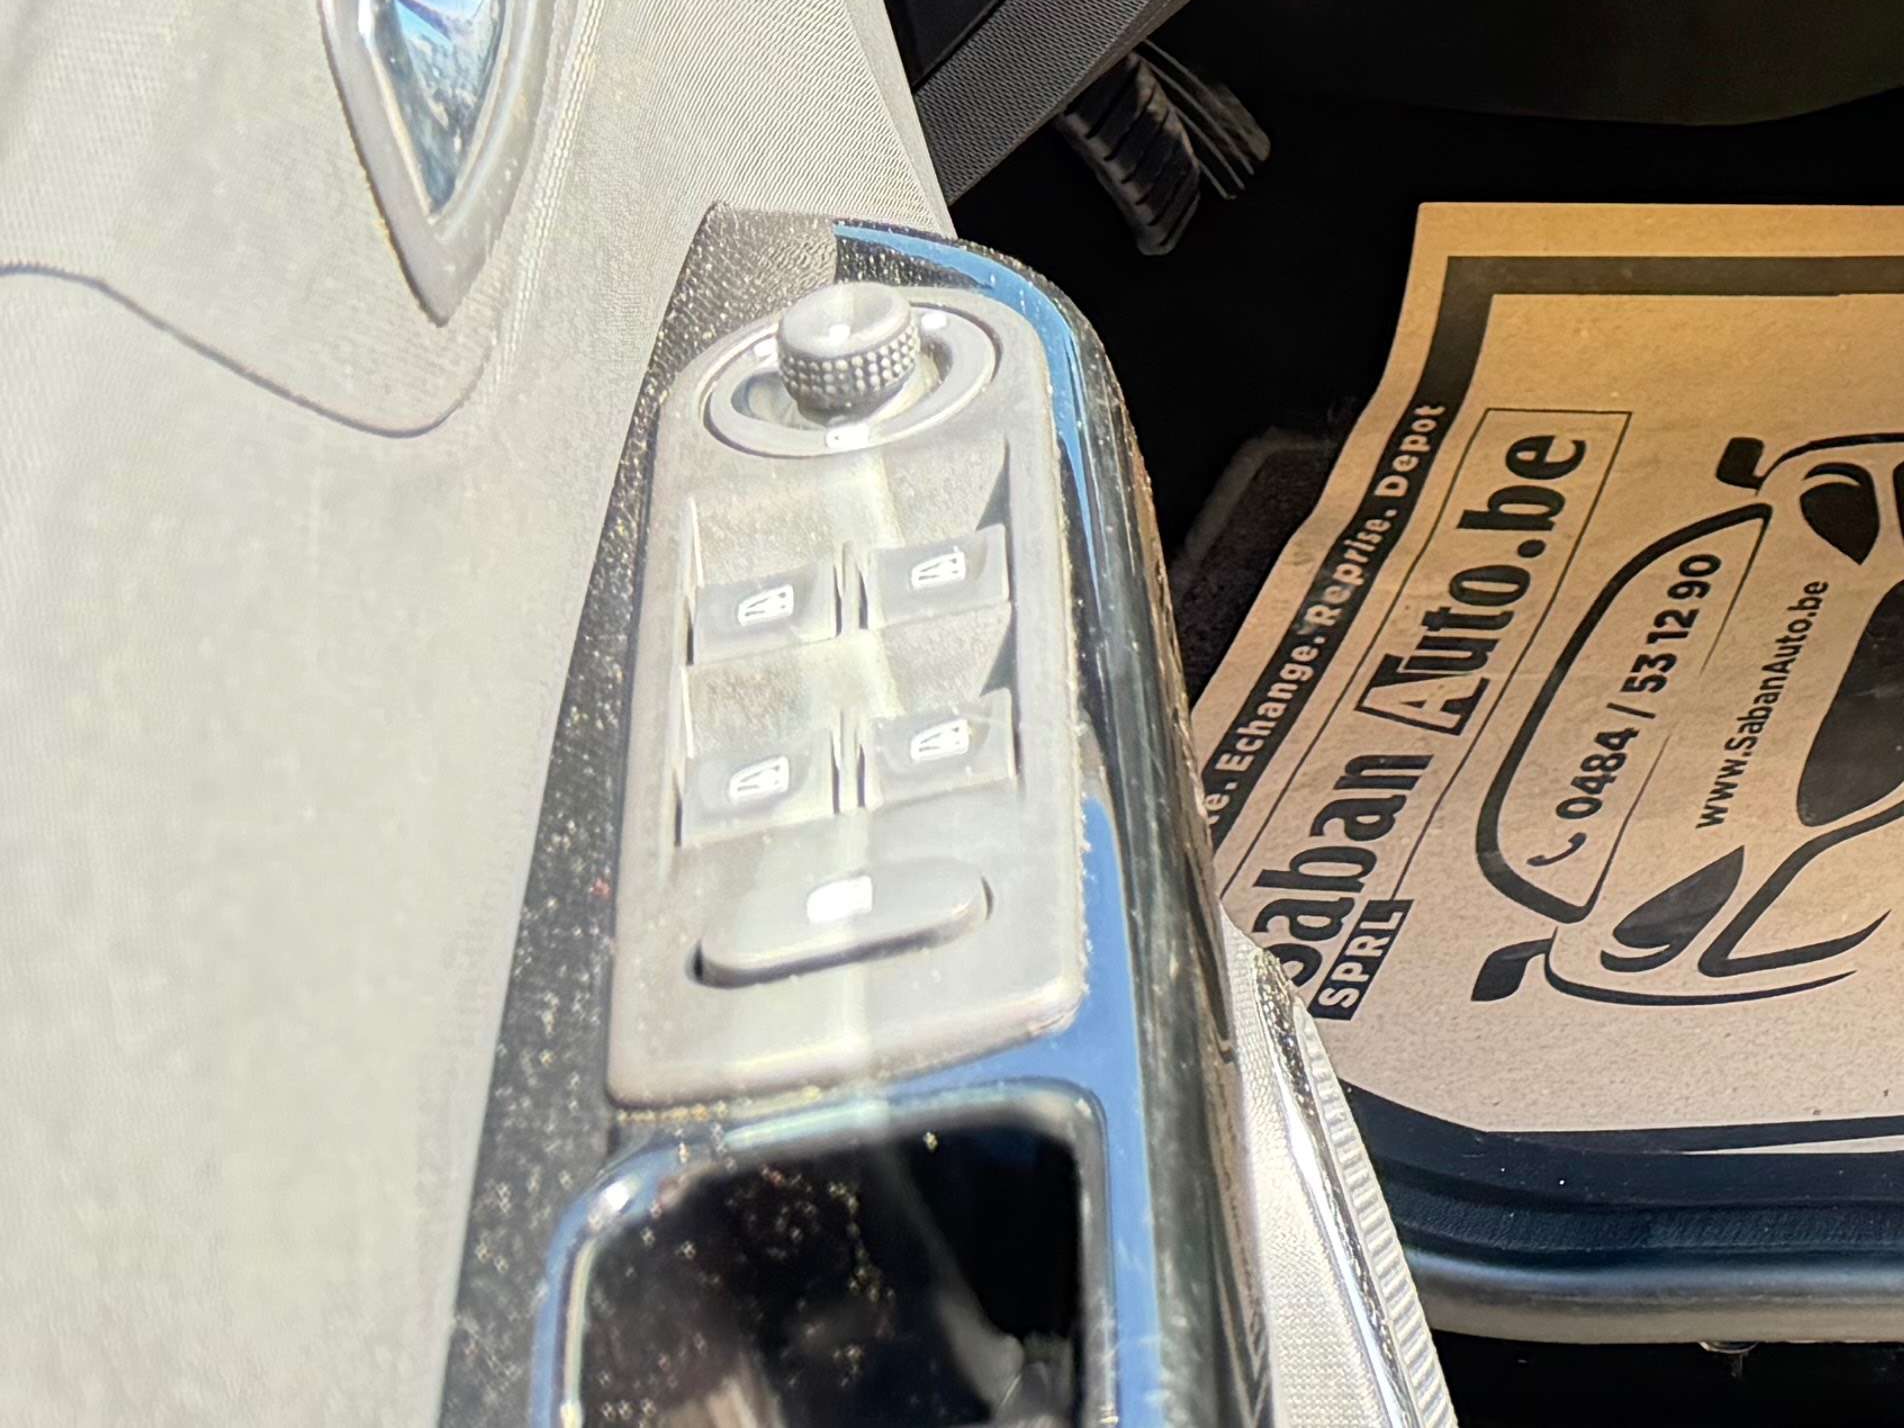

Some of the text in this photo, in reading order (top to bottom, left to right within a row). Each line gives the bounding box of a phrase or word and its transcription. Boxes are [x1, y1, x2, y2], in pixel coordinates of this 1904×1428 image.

[1215, 629, 1327, 773] Echange.
[1305, 506, 1398, 627] Reprise.
[1374, 404, 1447, 499] Depot
[1356, 433, 1587, 734] Auto.be
[1666, 553, 1722, 601] 90
[1620, 652, 1678, 694] 53
[1646, 608, 1700, 646] 12
[1695, 580, 1829, 829] www.SabanAuto.be
[1555, 727, 1641, 820] 0484
[1317, 908, 1399, 1008] SPRL
